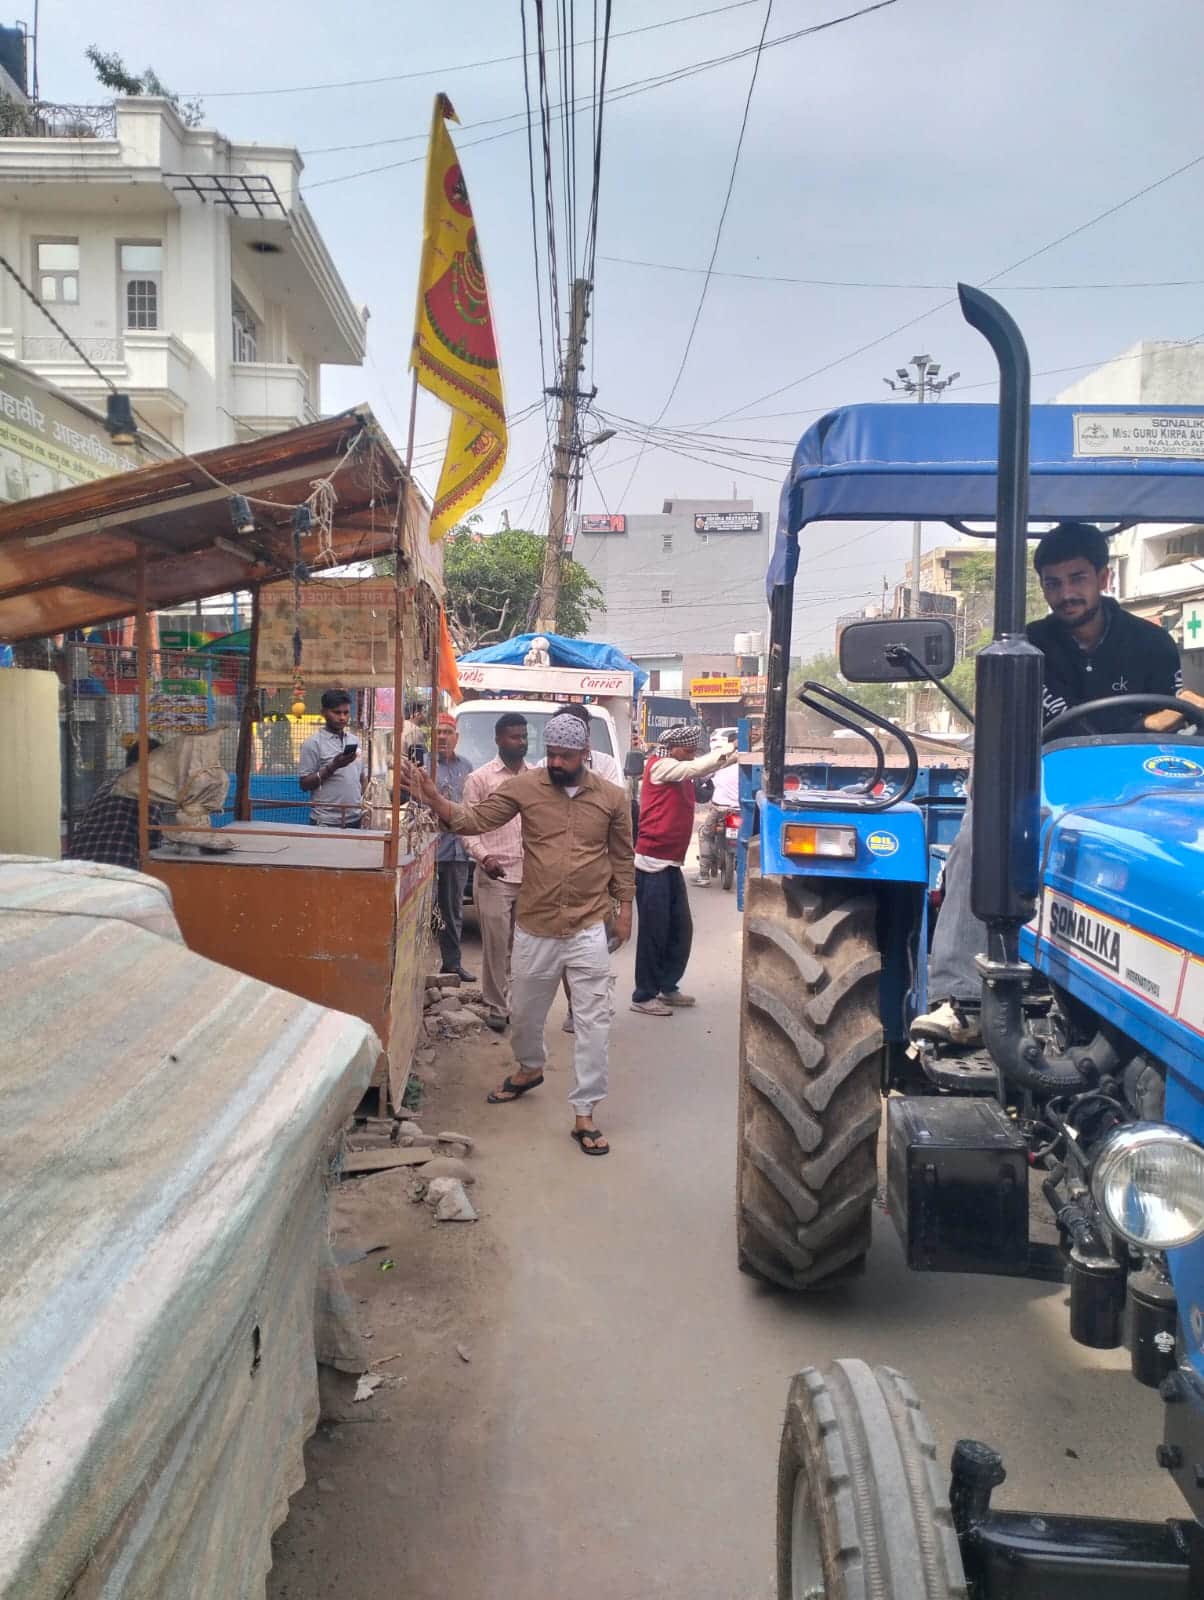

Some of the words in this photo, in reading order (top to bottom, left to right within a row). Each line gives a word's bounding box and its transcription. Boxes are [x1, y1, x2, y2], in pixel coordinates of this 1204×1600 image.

[1133, 428, 1158, 439] GURU
[1160, 428, 1186, 439] KIRPA
[580, 676, 623, 689] Carrier
[1111, 675, 1128, 691] ck
[1049, 901, 1121, 962] SONALIKA
